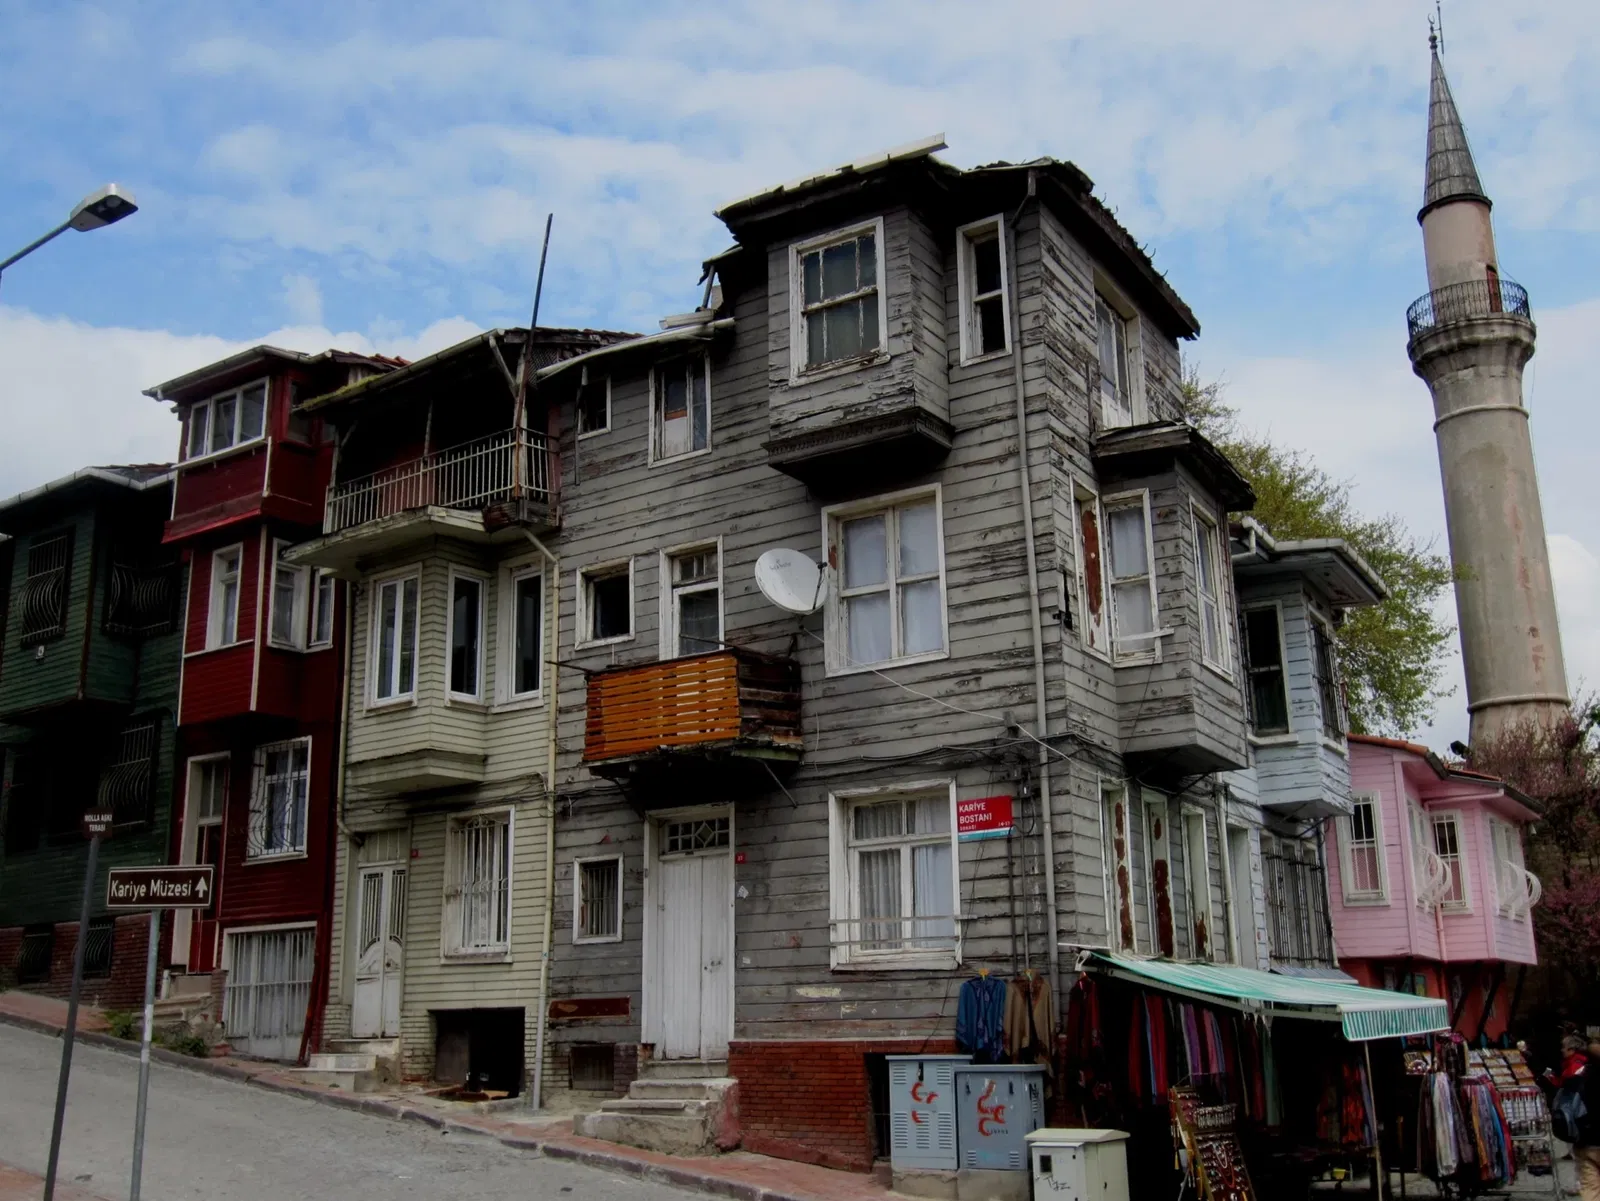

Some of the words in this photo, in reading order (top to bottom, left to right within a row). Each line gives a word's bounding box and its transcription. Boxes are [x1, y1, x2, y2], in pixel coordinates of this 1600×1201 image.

[959, 802, 986, 813] KARİYE
[959, 812, 993, 824] BOSTANI
[111, 880, 147, 902] Kariye
[150, 879, 192, 897] Müzesi
